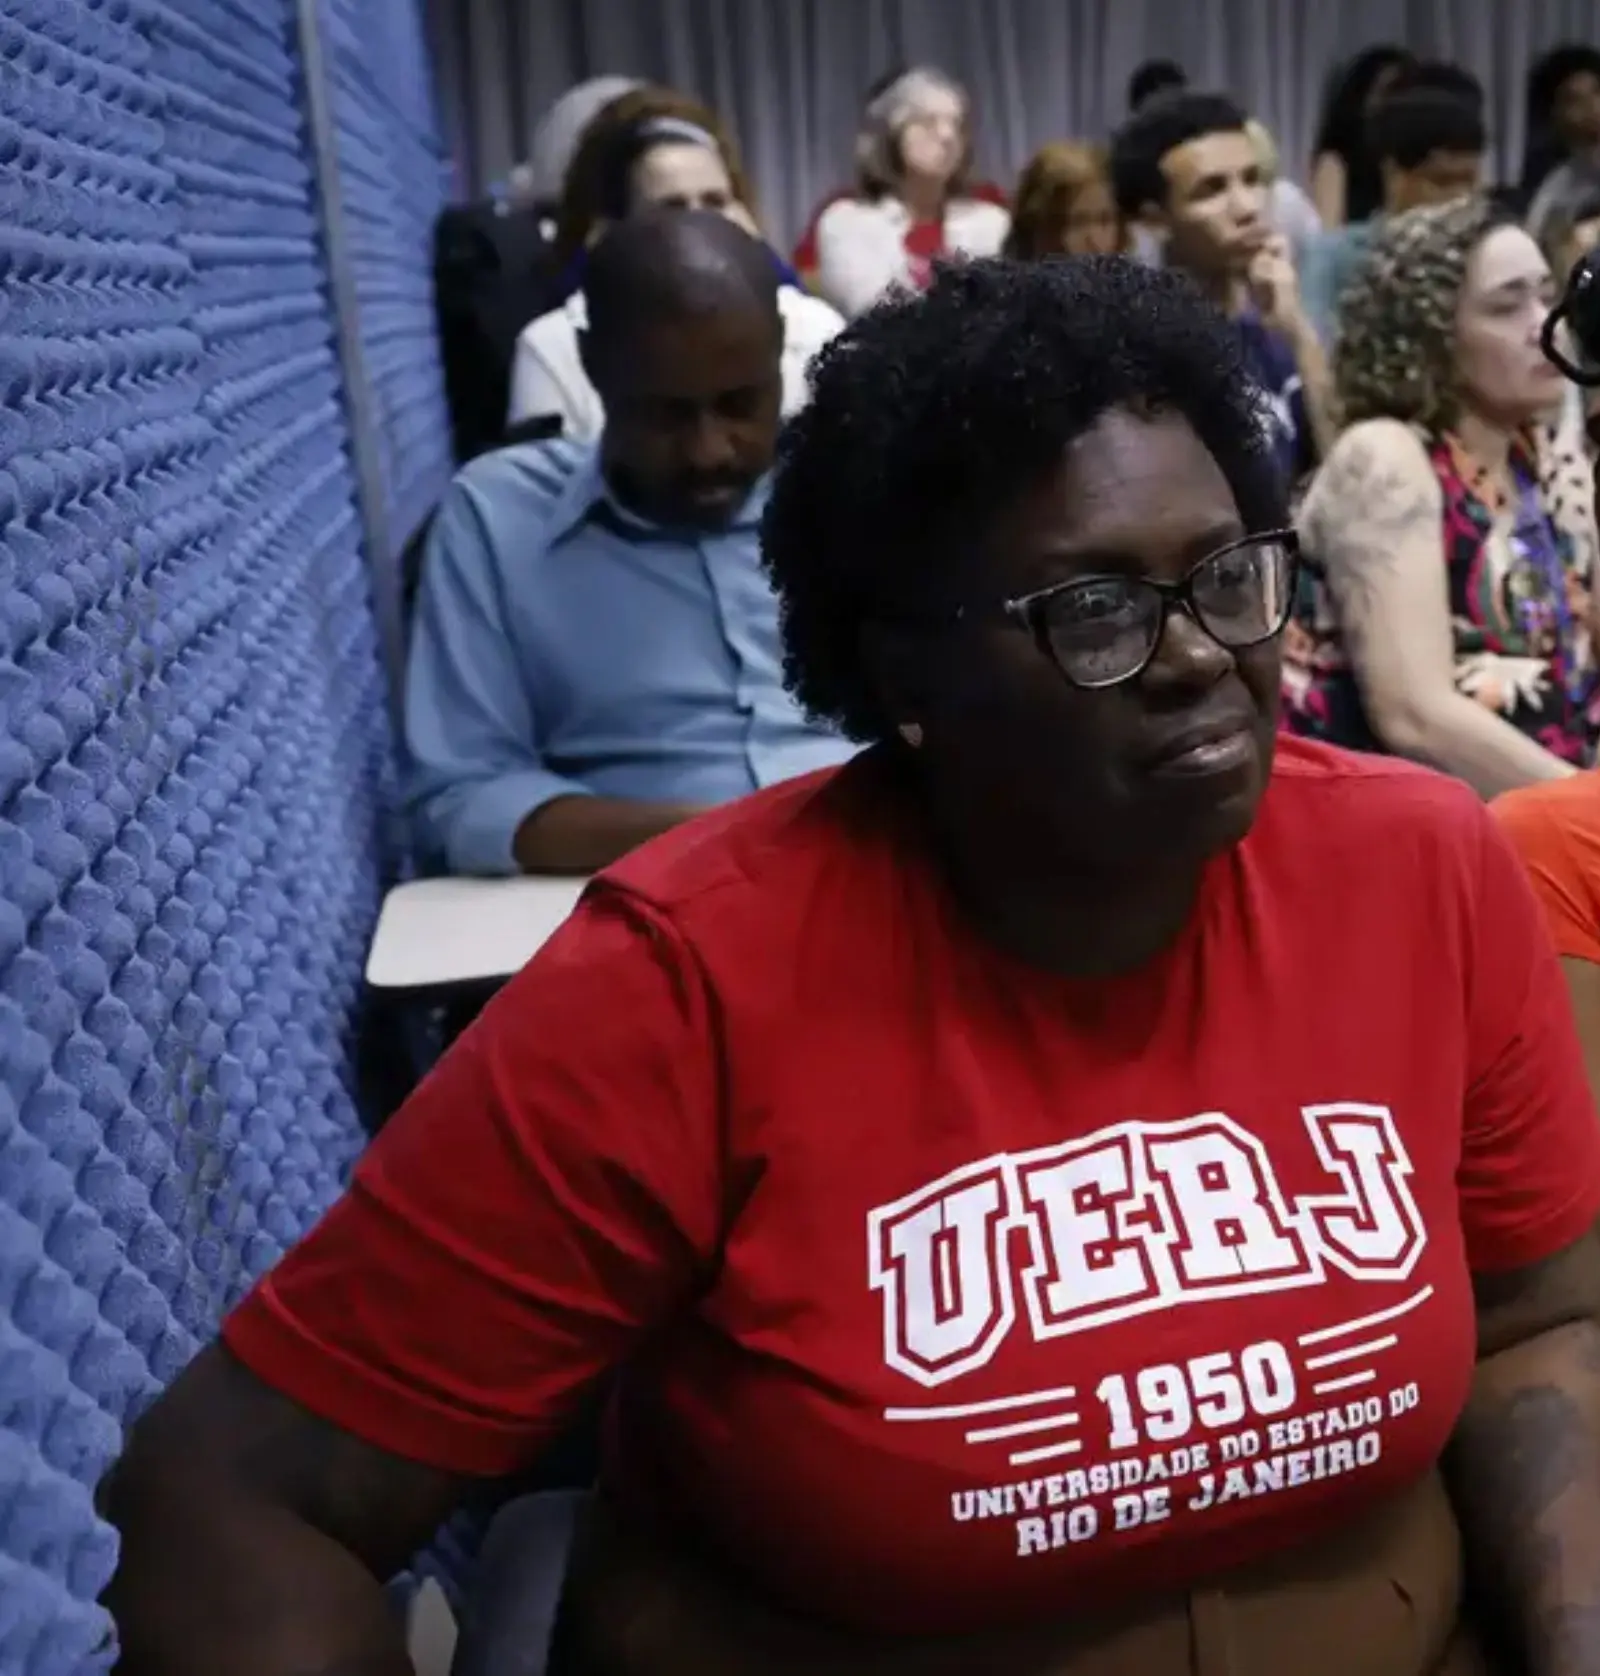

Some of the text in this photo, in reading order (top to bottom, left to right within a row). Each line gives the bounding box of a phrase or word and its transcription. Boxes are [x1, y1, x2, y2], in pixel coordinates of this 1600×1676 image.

[866, 1101, 1429, 1388] UERJ
[951, 1381, 1420, 1521] UNIVERSIDADE DO ESTADO DO
[1095, 1339, 1297, 1450] 1950
[1016, 1431, 1381, 1556] RIO DE JANEIRO
